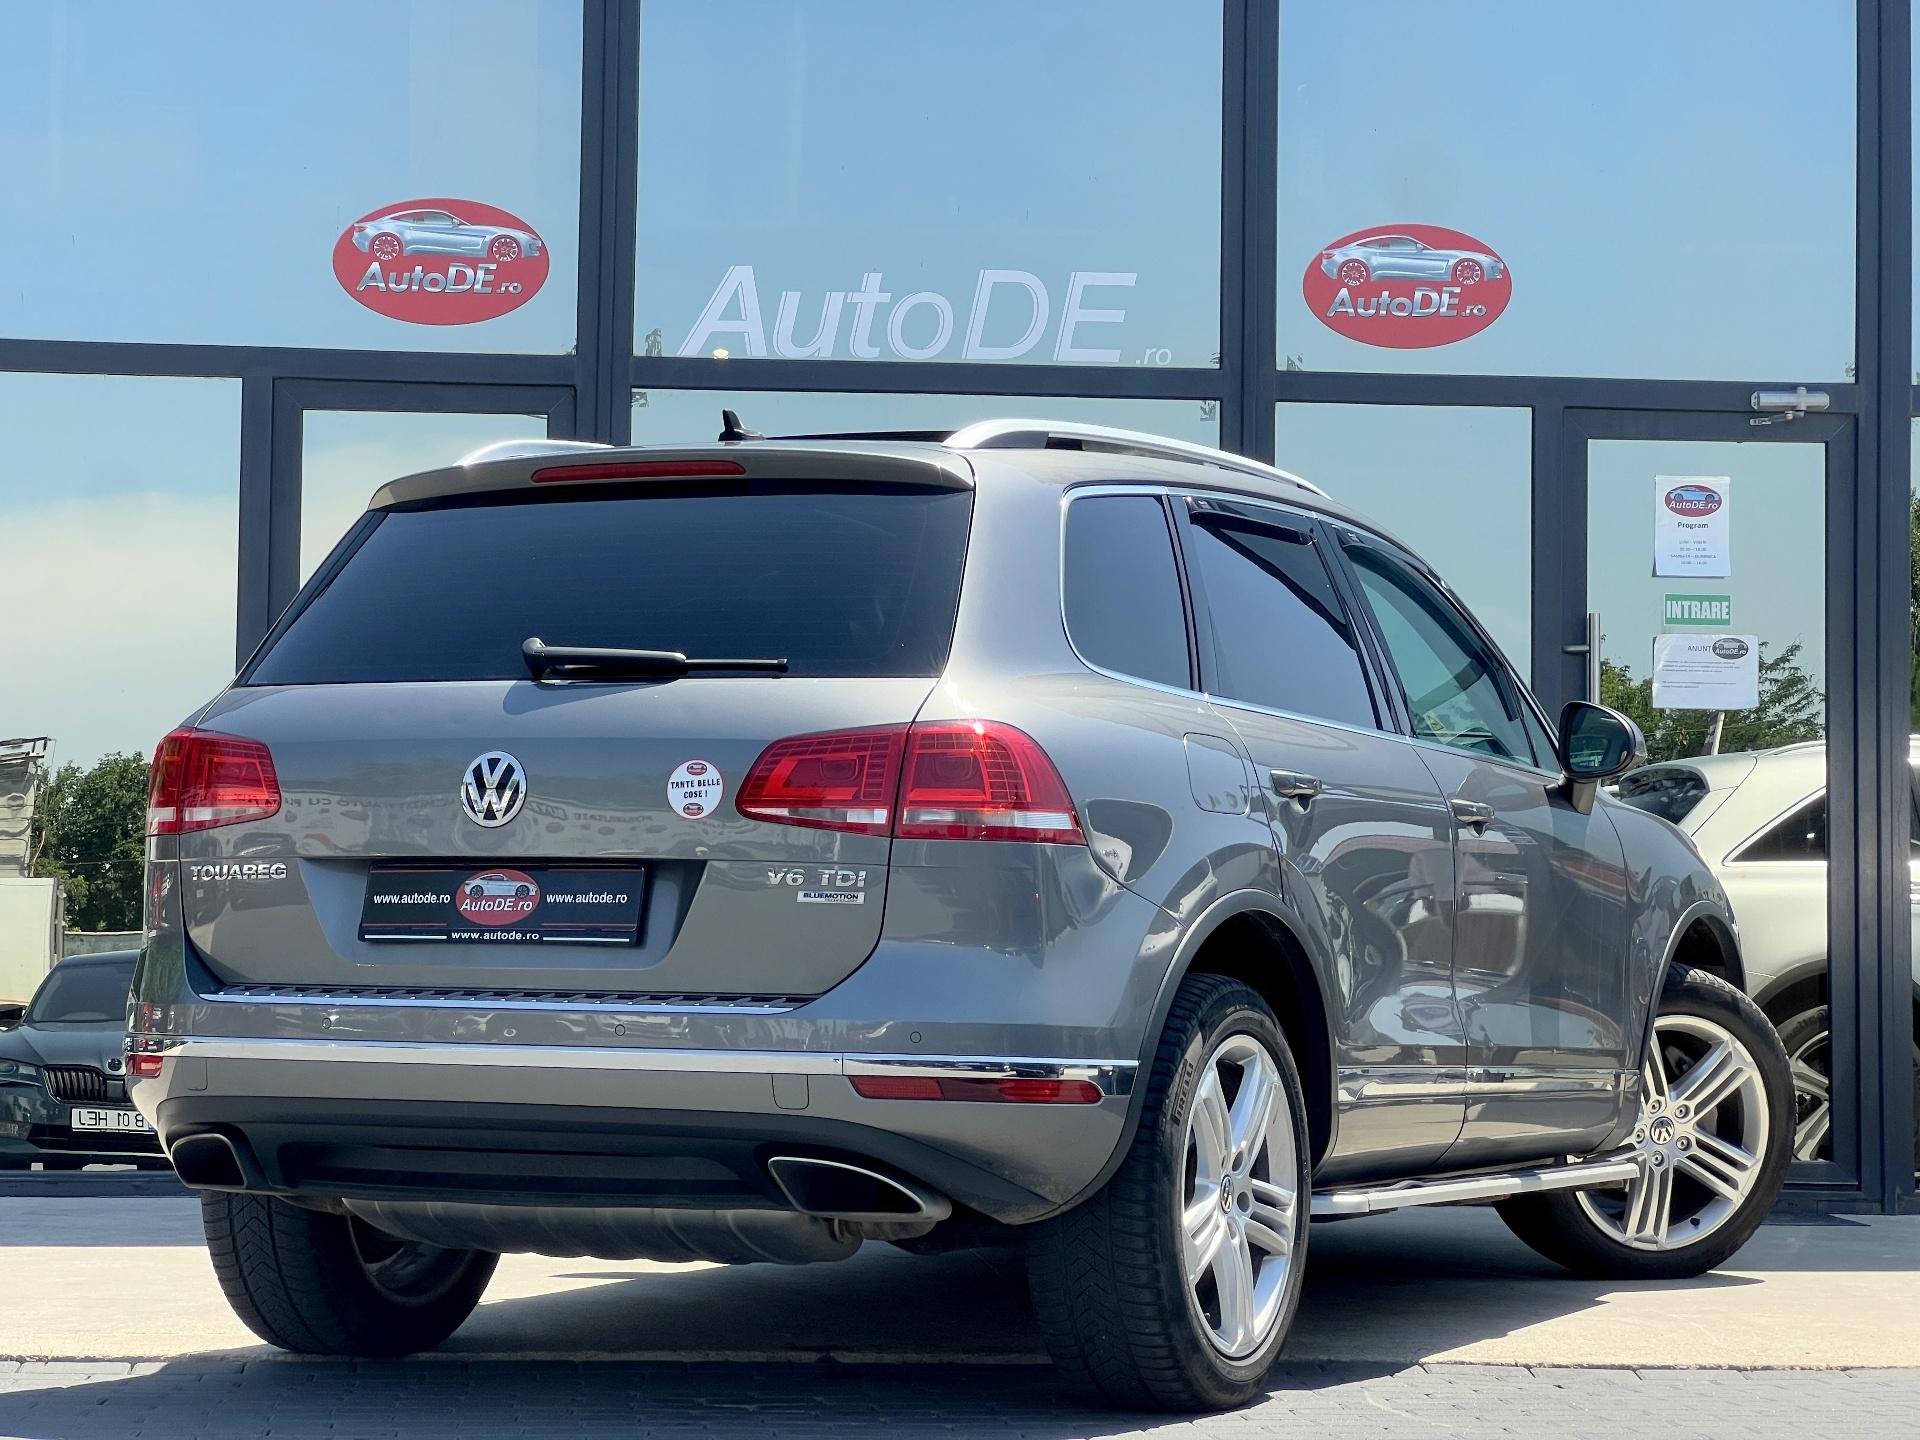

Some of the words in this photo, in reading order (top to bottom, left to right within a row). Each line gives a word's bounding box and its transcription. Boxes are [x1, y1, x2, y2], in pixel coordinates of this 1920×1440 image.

[1669, 501, 1718, 509] AutoDE.ro
[1677, 522, 1709, 530] Program
[1665, 600, 1729, 619] INTRARE
[671, 781, 694, 789] TANTE
[697, 778, 720, 787] BELLE
[683, 791, 702, 799] COSE
[190, 863, 288, 881] TOUAREG
[767, 867, 806, 886] V6
[818, 869, 867, 888] TDI
[373, 891, 450, 904] www.autode.ro
[546, 892, 627, 904] www.autode.ro
[803, 892, 859, 900] BLUEMOTION
[460, 898, 533, 912] AutoDE.ro
[451, 931, 539, 941] www.autode.ro
[1171, 1058, 1194, 1126] PIRELLI
